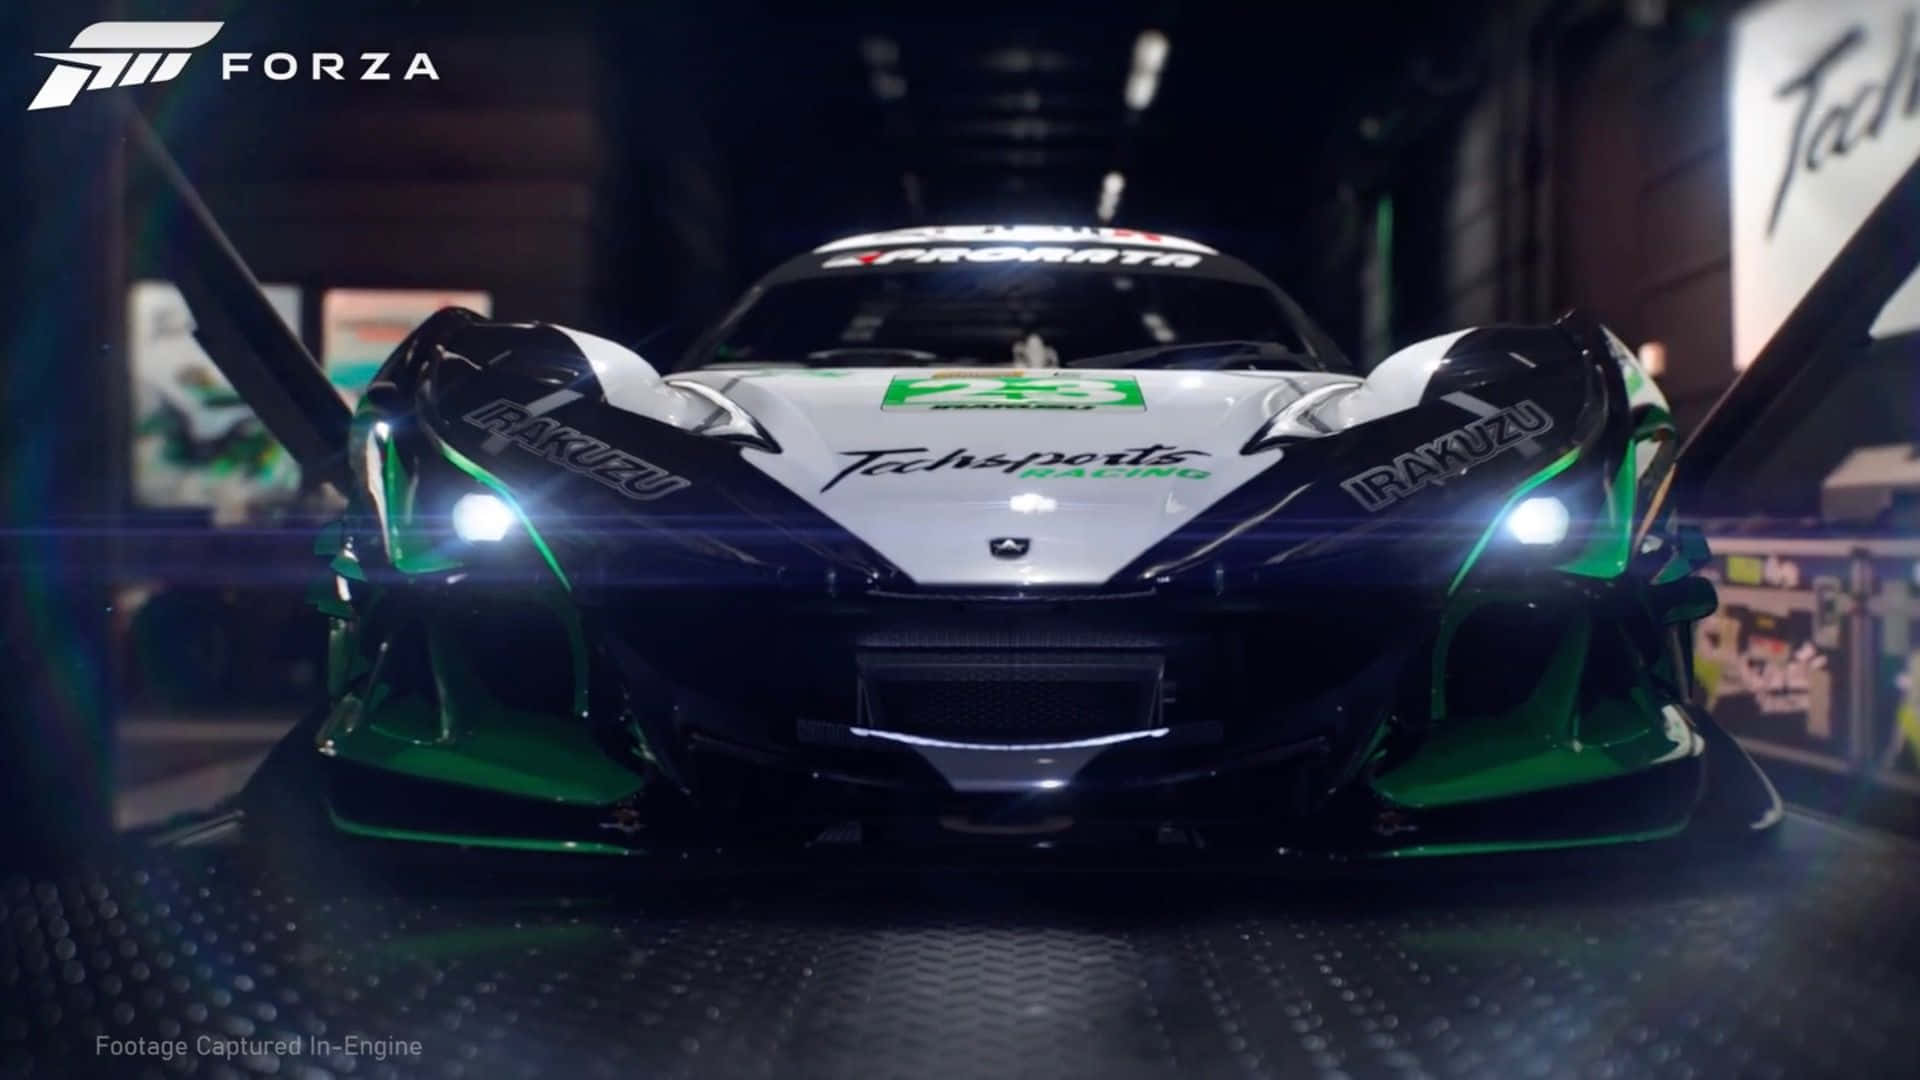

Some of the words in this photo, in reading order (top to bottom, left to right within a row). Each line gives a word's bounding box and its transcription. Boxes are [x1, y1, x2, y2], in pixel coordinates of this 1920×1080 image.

[873, 247, 1203, 269] PRORATA
[904, 378, 1128, 404] 23
[462, 398, 693, 501] IRAKUZU
[1339, 399, 1556, 513] IRAKUZU
[1019, 467, 1213, 481] RACING
